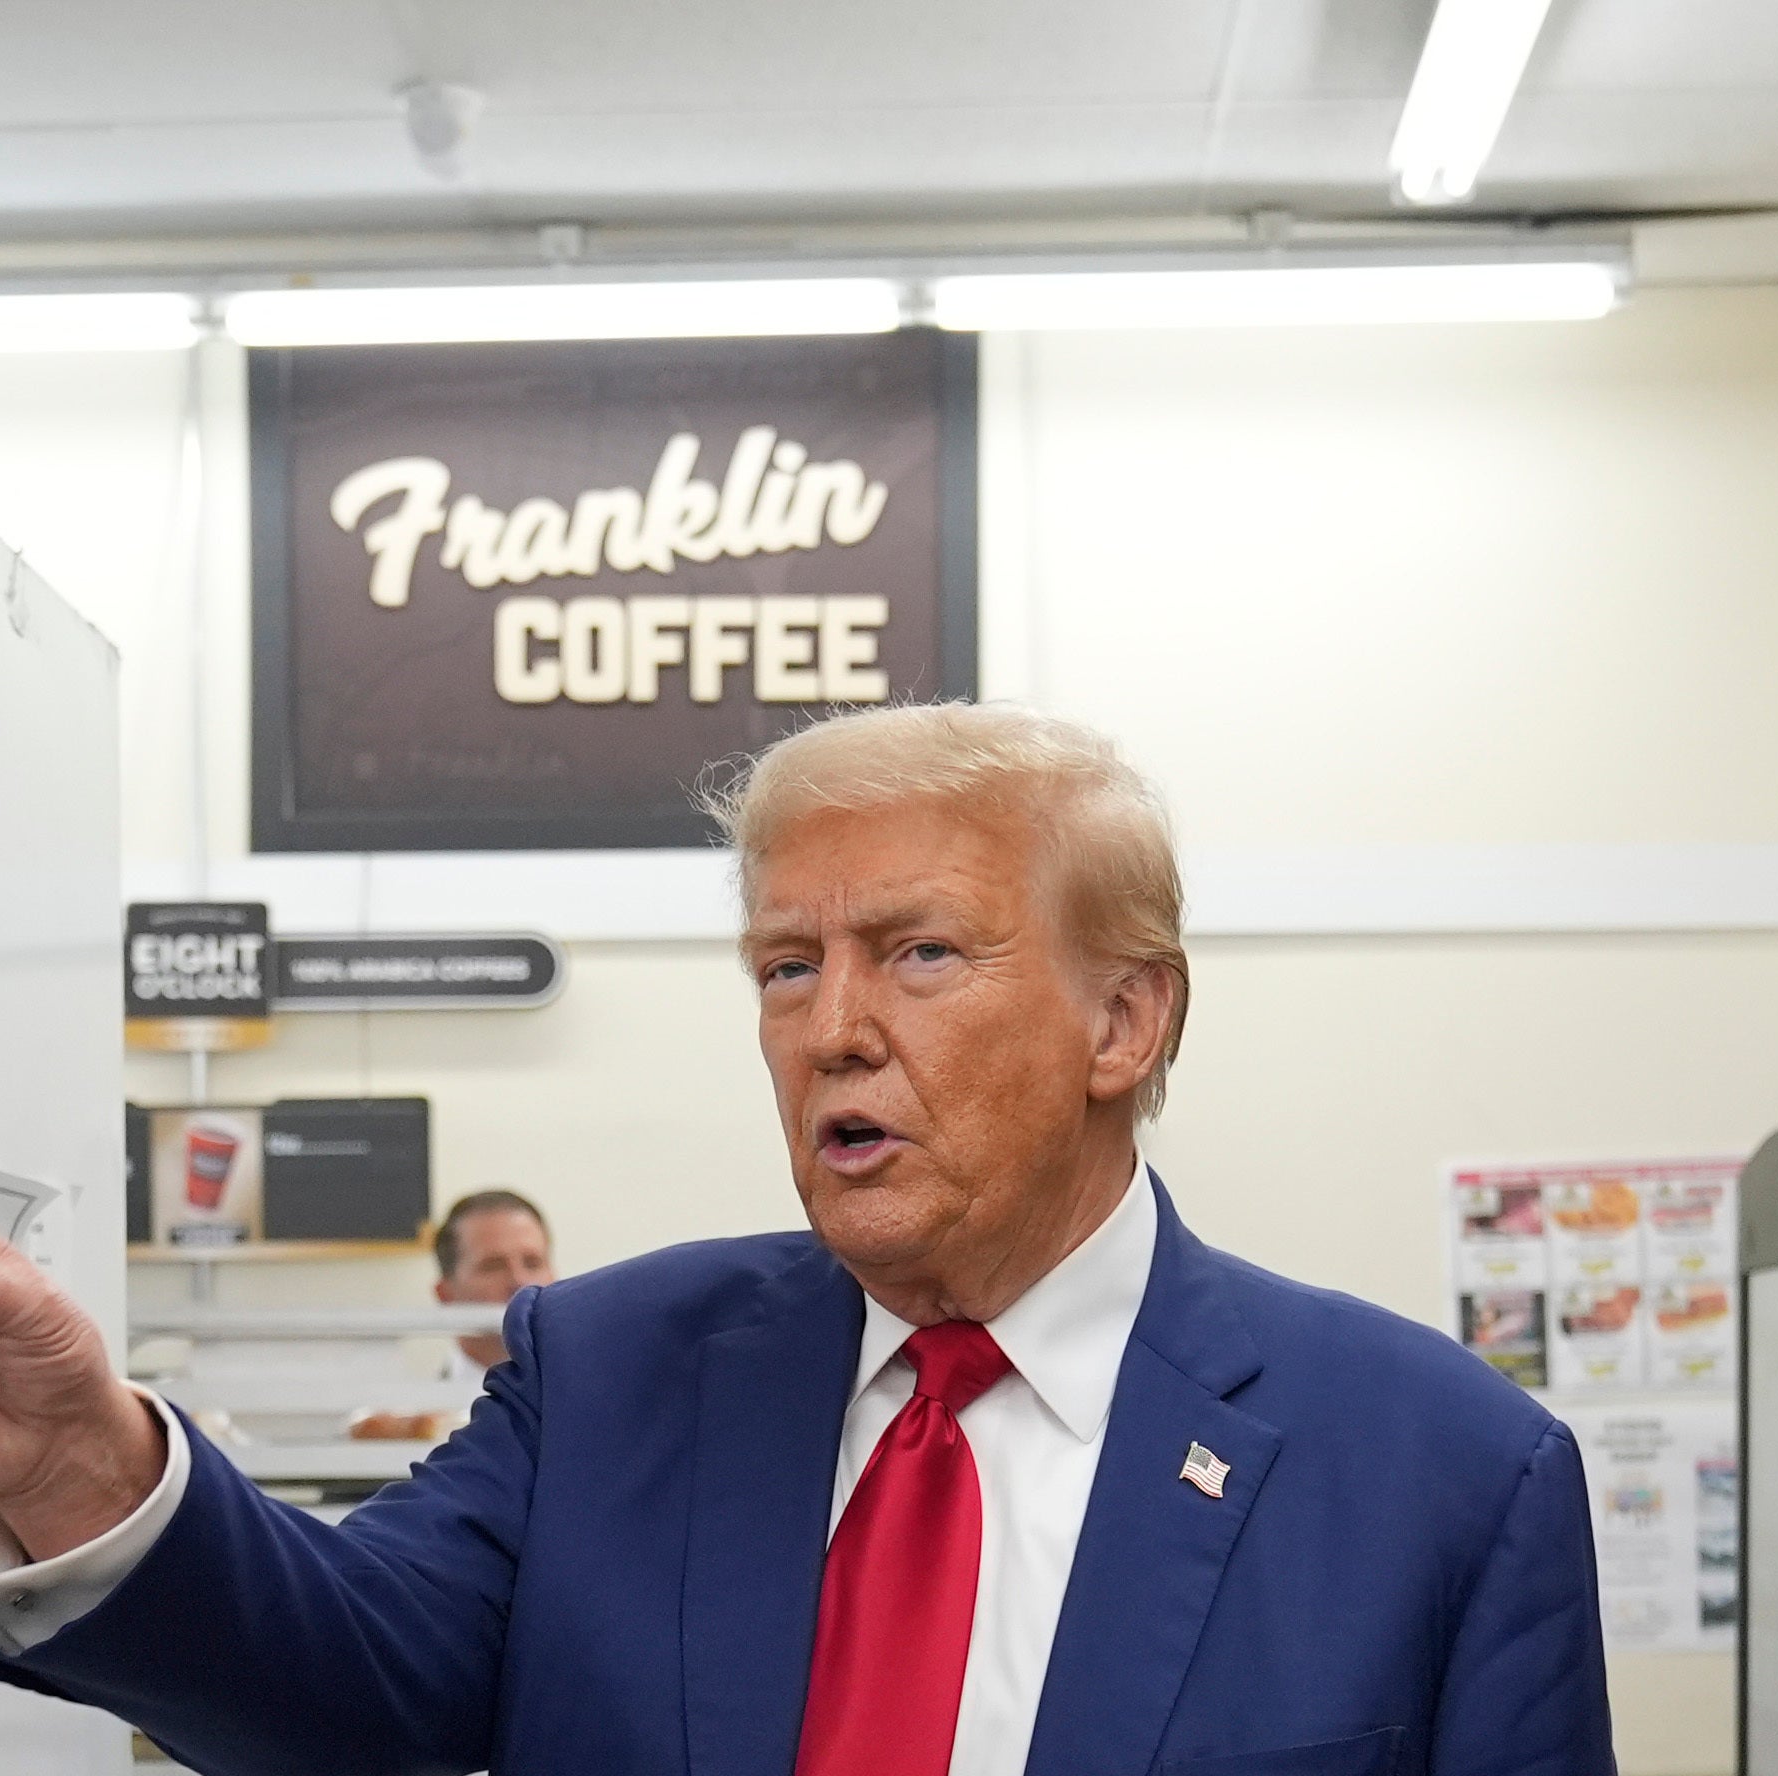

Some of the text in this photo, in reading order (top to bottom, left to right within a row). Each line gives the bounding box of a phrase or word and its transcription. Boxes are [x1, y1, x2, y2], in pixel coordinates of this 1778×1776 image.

[330, 425, 888, 607] Franklin
[493, 595, 890, 703] COFFEE
[130, 932, 264, 974] EIGHT
[130, 973, 262, 1001] O'CLOCK
